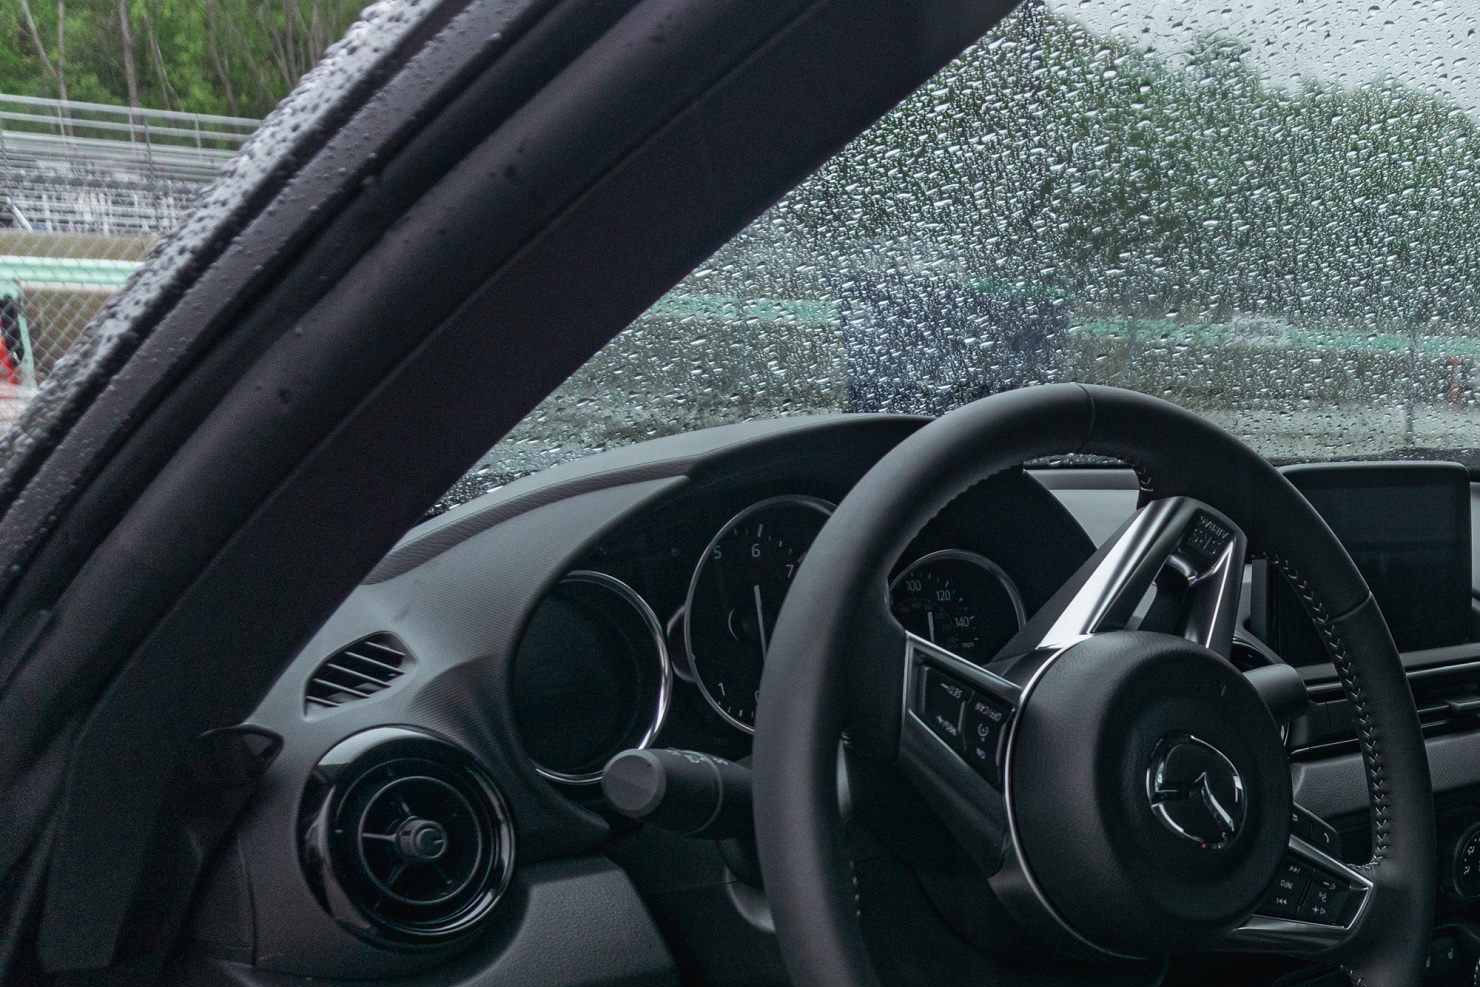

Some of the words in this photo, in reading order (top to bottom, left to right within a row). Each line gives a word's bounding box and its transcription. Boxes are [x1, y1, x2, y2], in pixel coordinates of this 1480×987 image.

[713, 545, 722, 560] 5
[751, 543, 761, 558] 6
[785, 563, 795, 578] 7
[905, 580, 922, 591] 100
[936, 589, 951, 601] 120
[954, 615, 970, 628] 140
[962, 641, 975, 649] mph
[718, 682, 726, 696] 1
